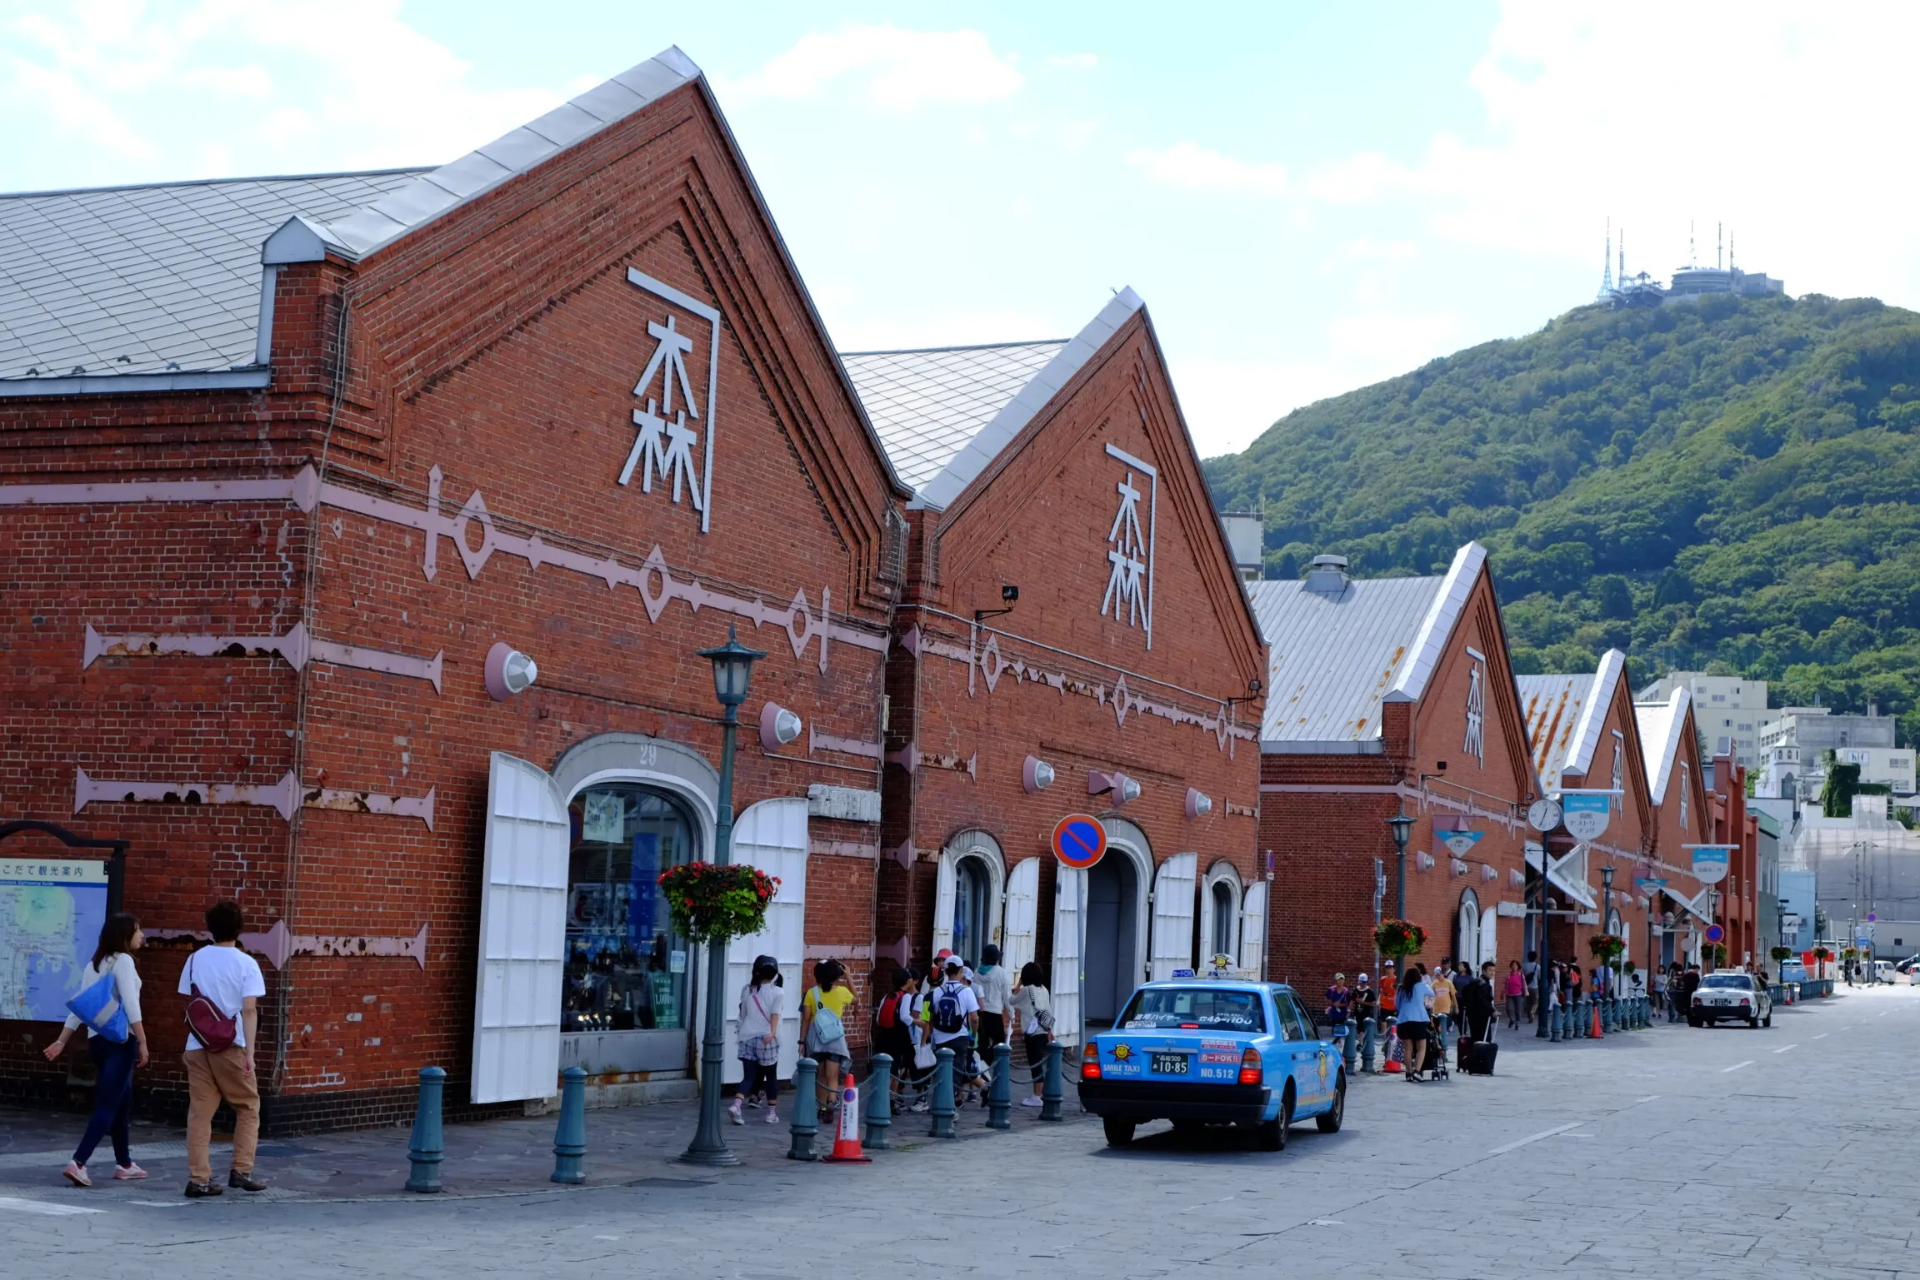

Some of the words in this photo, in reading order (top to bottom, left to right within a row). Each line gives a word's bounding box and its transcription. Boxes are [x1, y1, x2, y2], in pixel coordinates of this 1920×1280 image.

[640, 743, 657, 767] 29
[3, 864, 84, 878] こだて観光案内
[1103, 1064, 1122, 1072] SMILE
[1124, 1065, 1140, 1073] TAXI
[1201, 1068, 1234, 1079] NO.512
